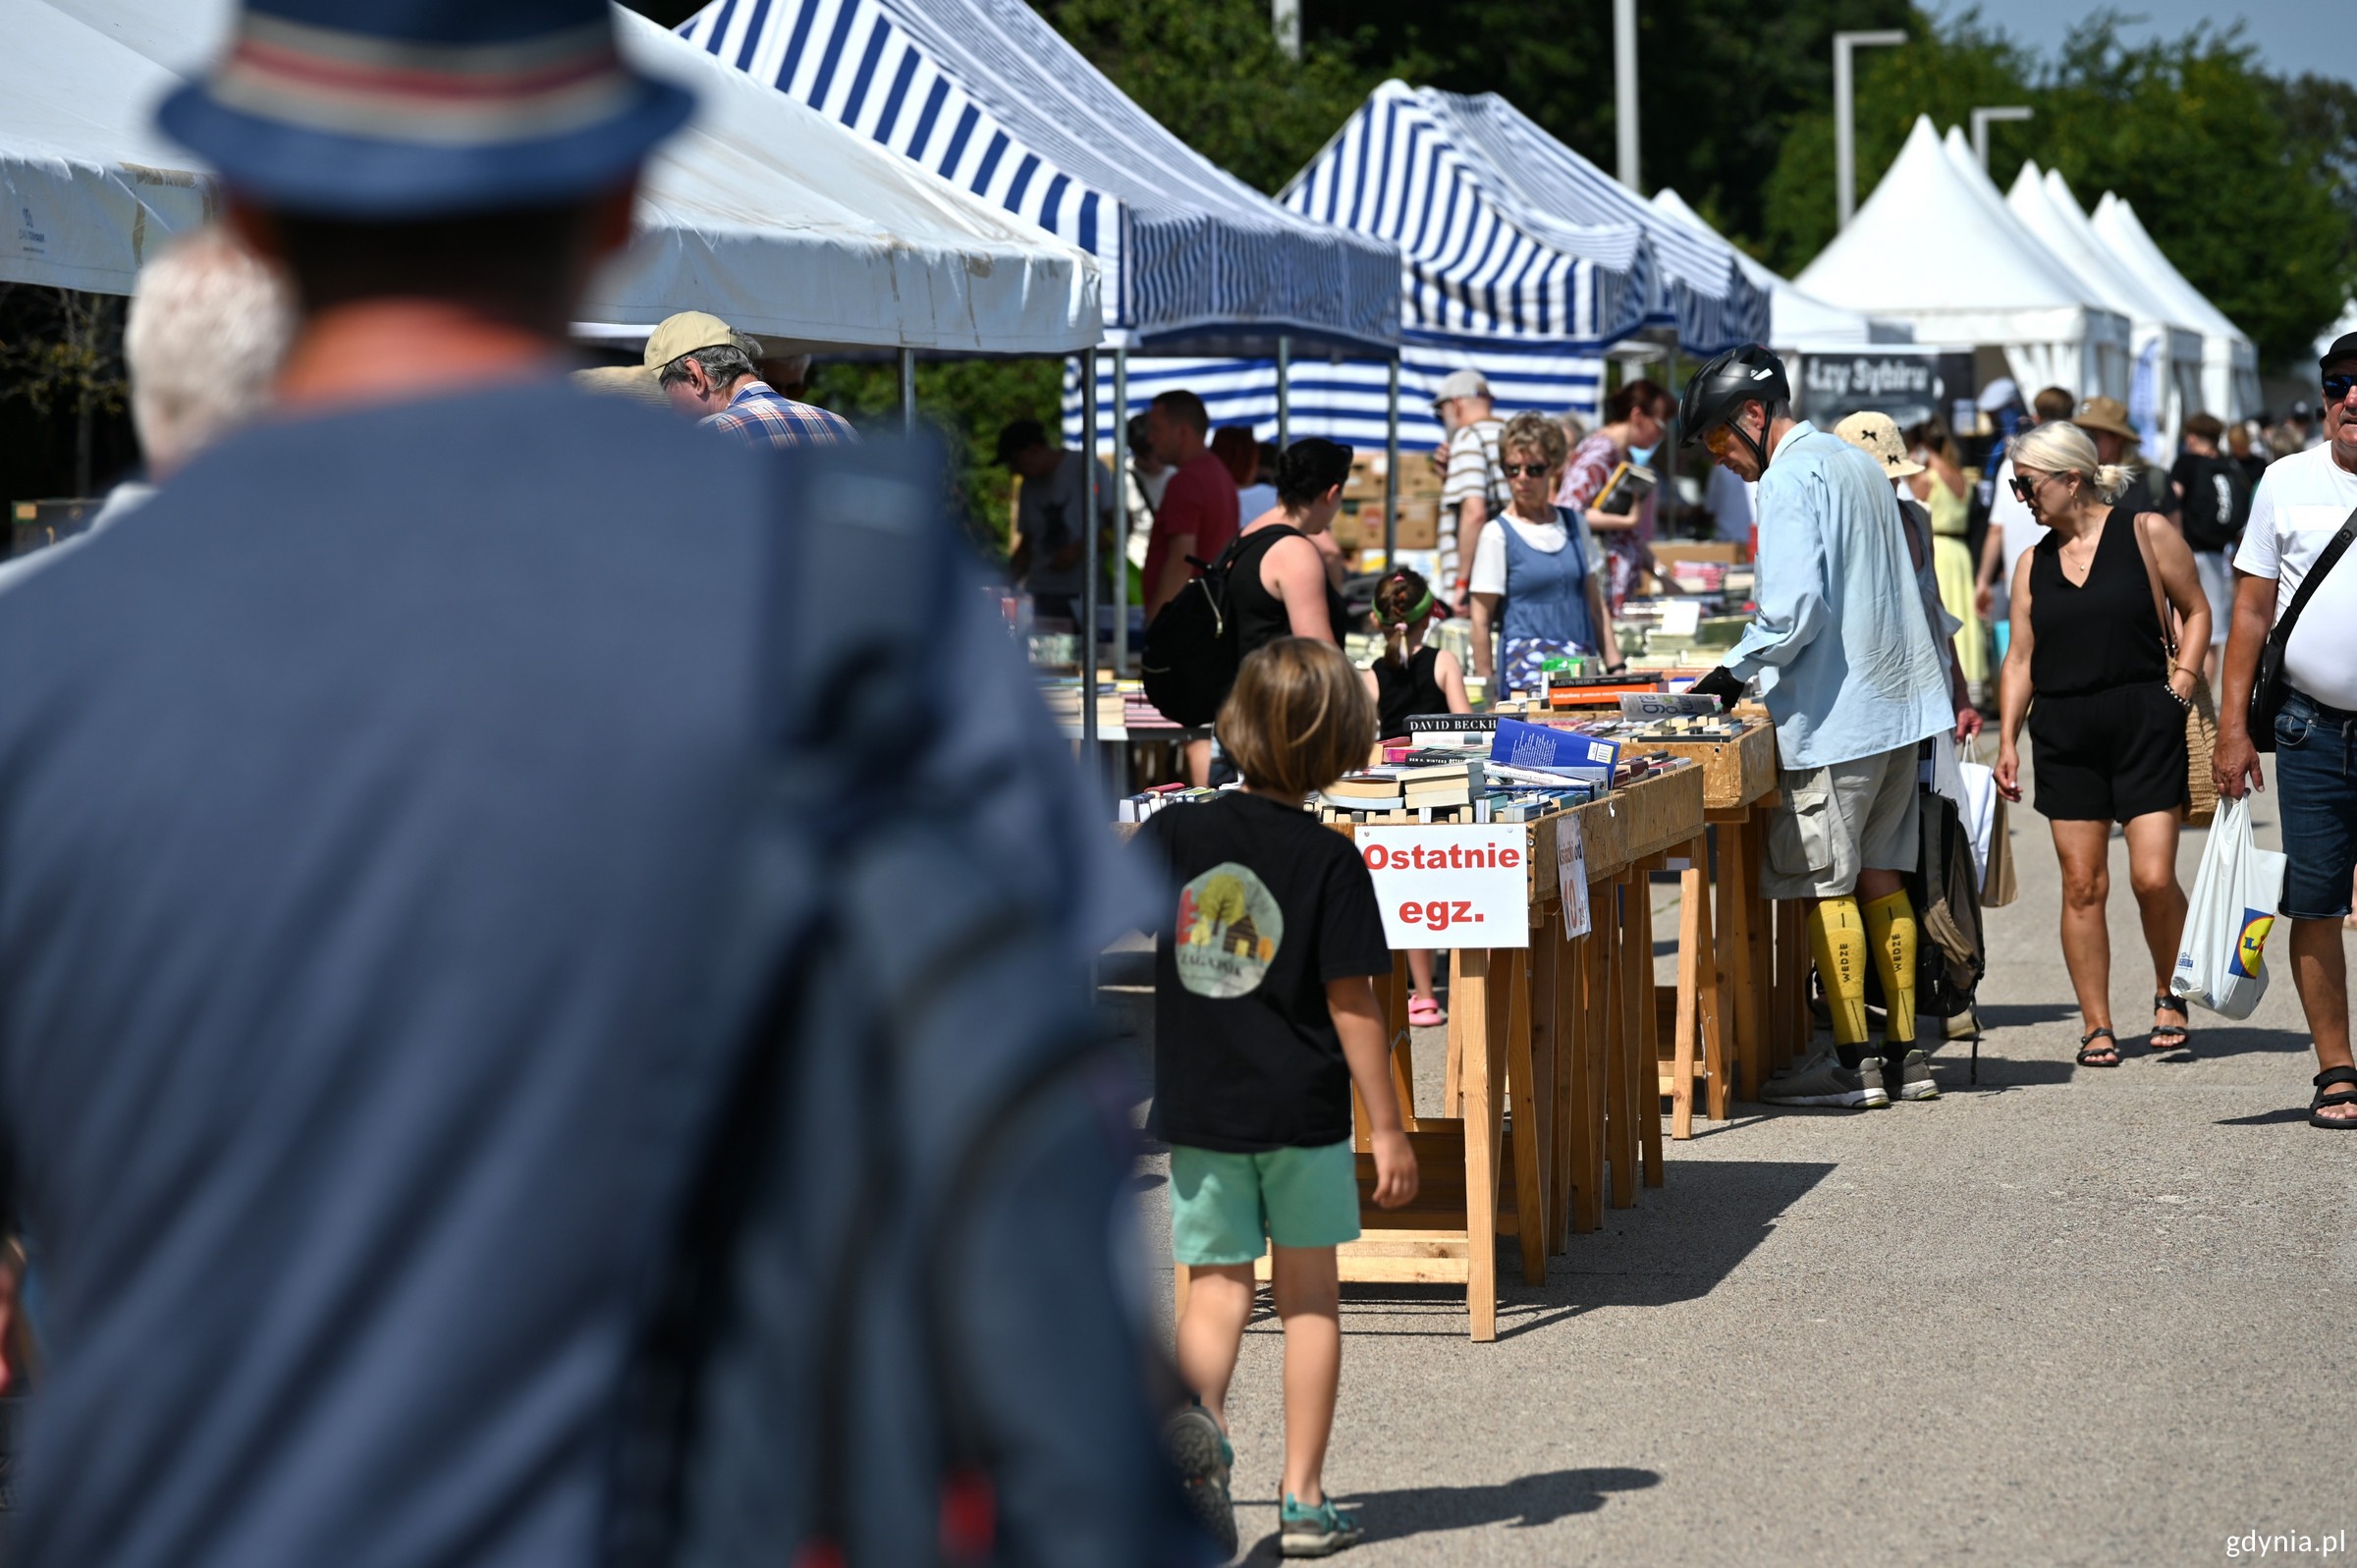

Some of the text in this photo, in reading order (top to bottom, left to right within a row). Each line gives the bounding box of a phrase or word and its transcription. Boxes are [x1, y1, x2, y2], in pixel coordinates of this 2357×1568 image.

[1554, 678, 1574, 687] JUSTIN
[1409, 720, 1497, 730] DAVID BECKH
[1363, 842, 1520, 870] Ostatnie
[1398, 900, 1484, 932] egz.
[1563, 879, 1577, 930] 10
[1839, 943, 1849, 983] WEDZE
[1891, 933, 1902, 972] WEDZE
